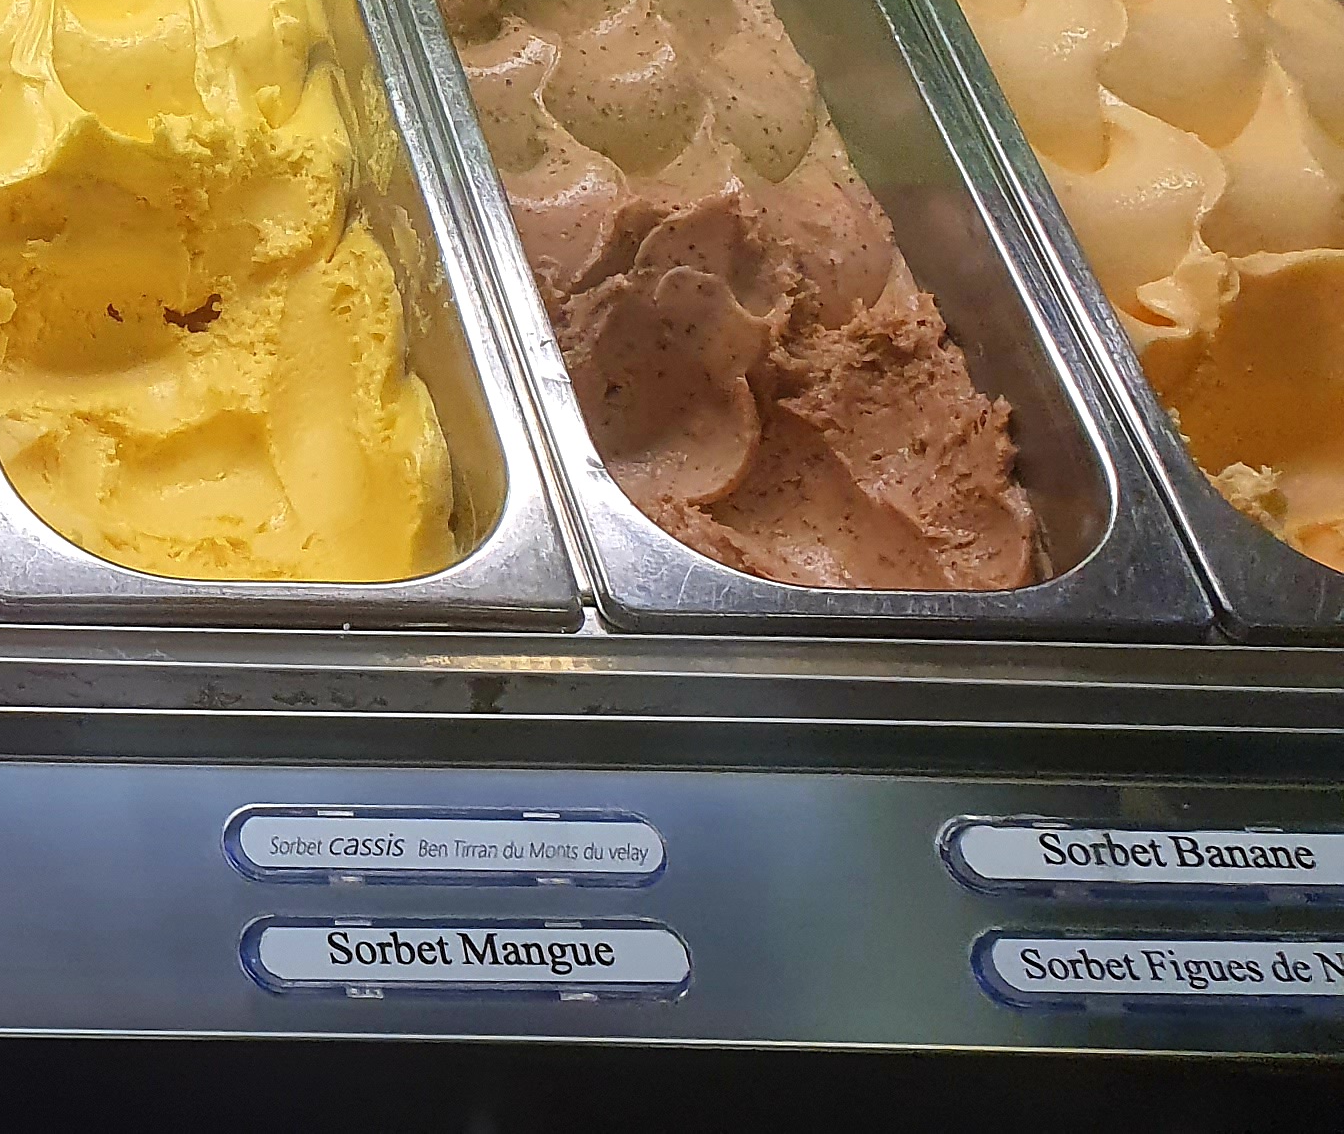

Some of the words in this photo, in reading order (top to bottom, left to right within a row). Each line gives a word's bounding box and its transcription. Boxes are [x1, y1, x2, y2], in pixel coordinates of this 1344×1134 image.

[269, 836, 324, 857] Sorbet
[329, 832, 405, 858] cassis
[418, 840, 449, 859] Ben
[503, 840, 525, 861] du
[529, 842, 578, 861] Monts
[583, 842, 605, 861] du
[608, 843, 649, 866] velay
[1038, 833, 1167, 868] Sorbet
[1169, 836, 1317, 869] Banane
[327, 932, 453, 967] Sorbet
[460, 933, 615, 975] Mangue
[1019, 949, 1138, 981] Sorbet
[1141, 950, 1263, 990] Figues
[1270, 951, 1313, 984] de
